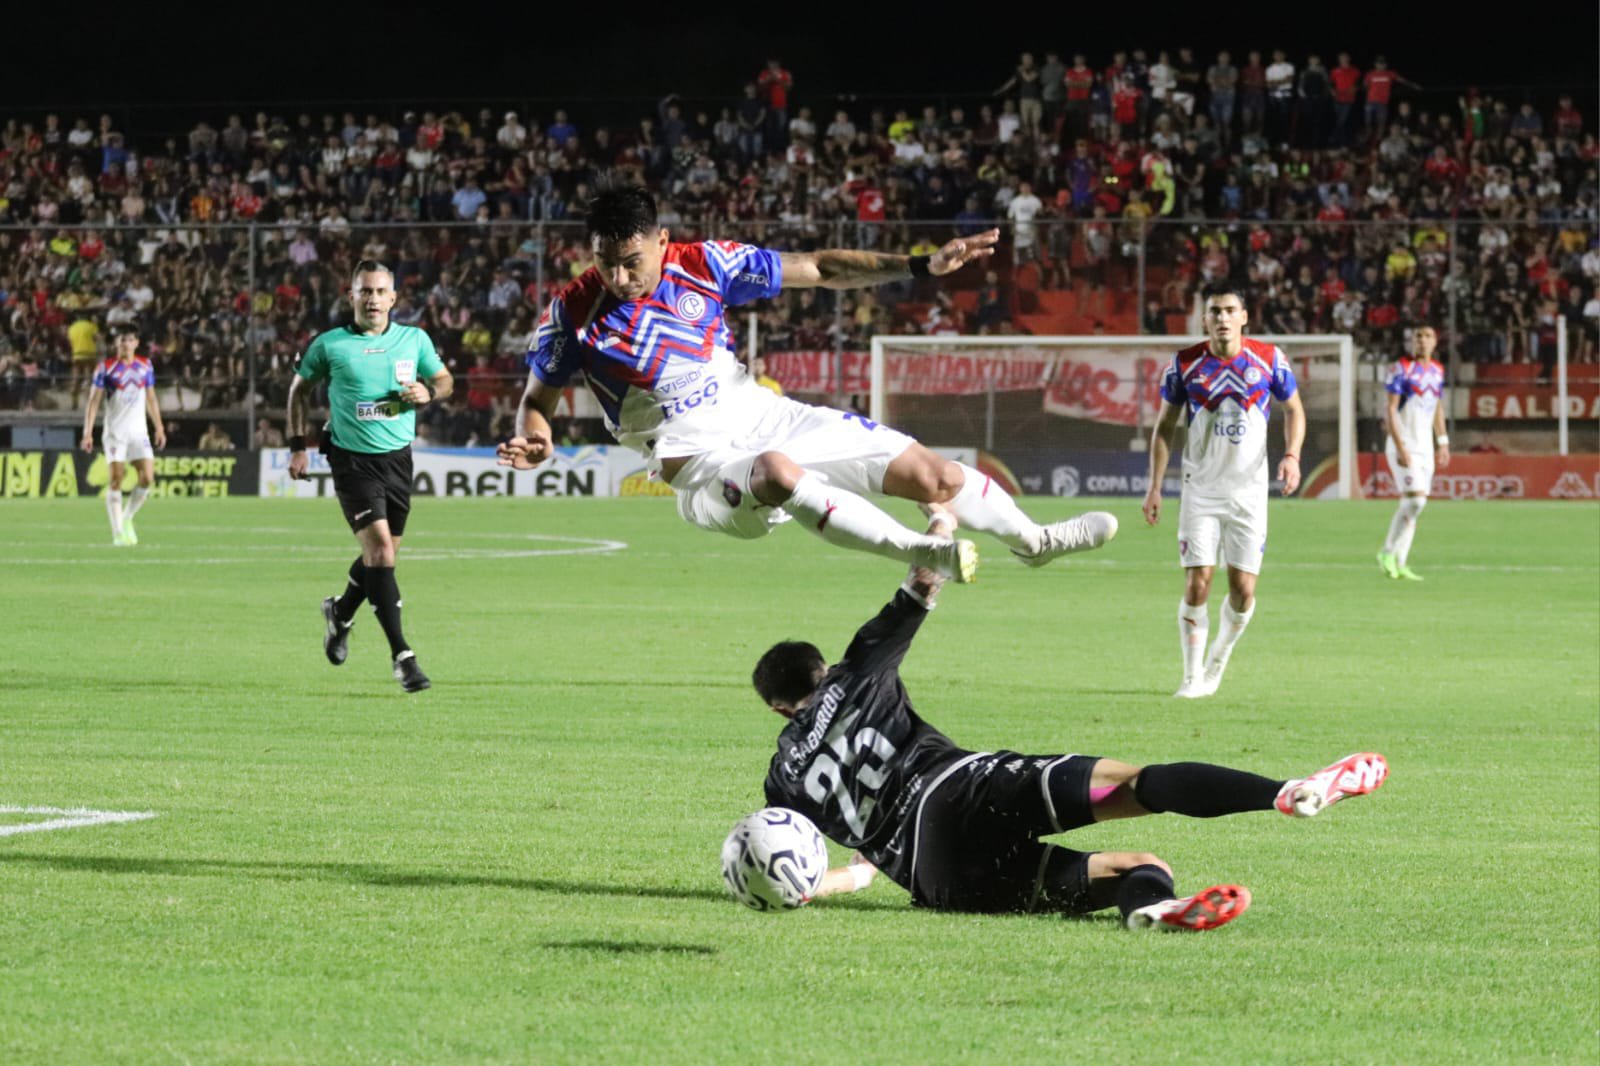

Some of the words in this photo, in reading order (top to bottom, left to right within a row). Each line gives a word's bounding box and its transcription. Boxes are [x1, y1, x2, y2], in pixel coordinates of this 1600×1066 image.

[1214, 420, 1247, 445] tigo
[0, 452, 79, 497] MA
[153, 456, 236, 476] RESORT
[1087, 475, 1129, 492] COPA
[789, 683, 847, 767] SABORIDO
[804, 707, 897, 840] 25
